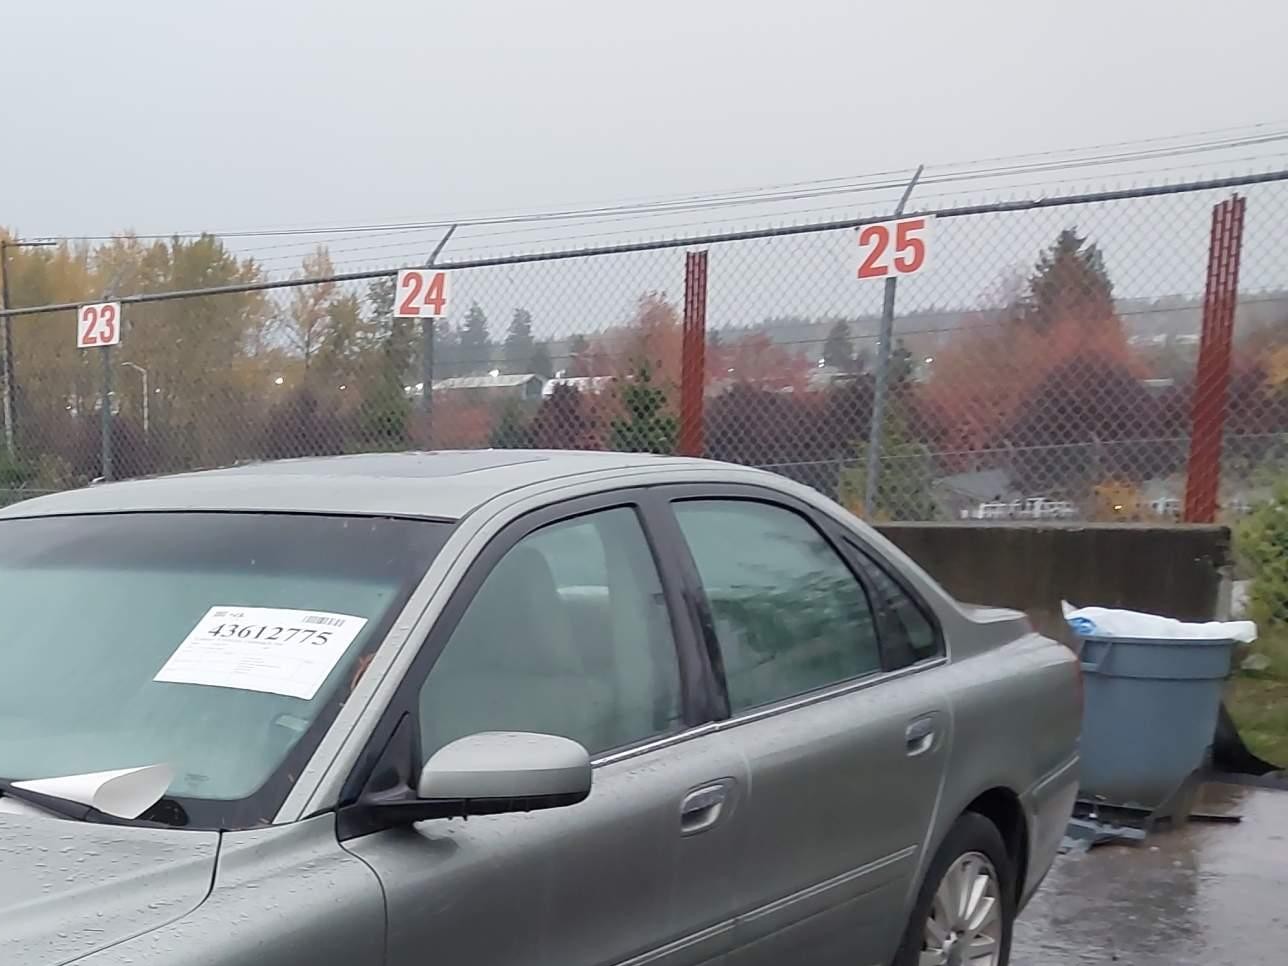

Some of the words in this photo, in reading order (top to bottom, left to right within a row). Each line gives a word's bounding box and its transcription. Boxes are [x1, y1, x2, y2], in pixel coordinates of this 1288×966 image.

[857, 219, 926, 279] 25
[399, 271, 446, 316] 24
[81, 304, 116, 345] 23
[208, 623, 333, 646] 43612775
